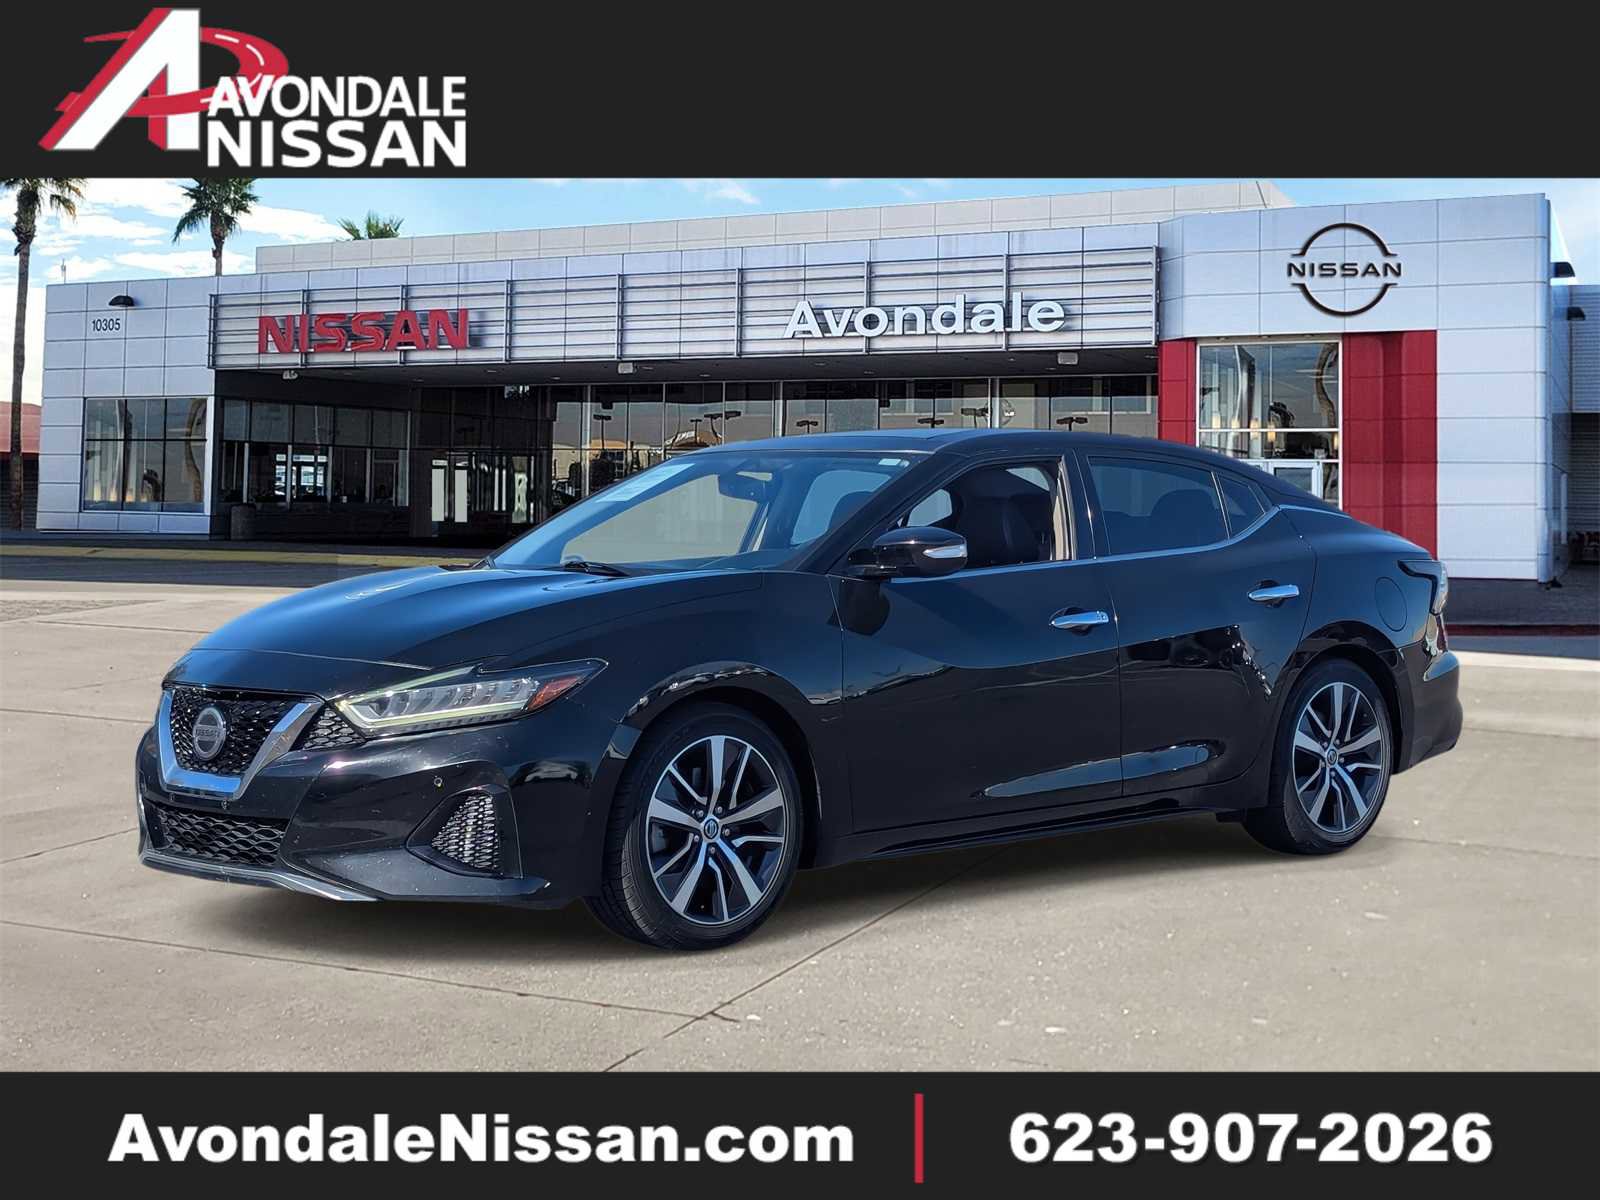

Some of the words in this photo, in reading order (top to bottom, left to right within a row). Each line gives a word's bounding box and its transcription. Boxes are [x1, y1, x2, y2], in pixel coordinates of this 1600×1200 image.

[1287, 262, 1402, 278] NISSAN
[91, 318, 121, 332] 10305
[783, 291, 1066, 338] Avondale
[258, 309, 469, 353] NISSAN
